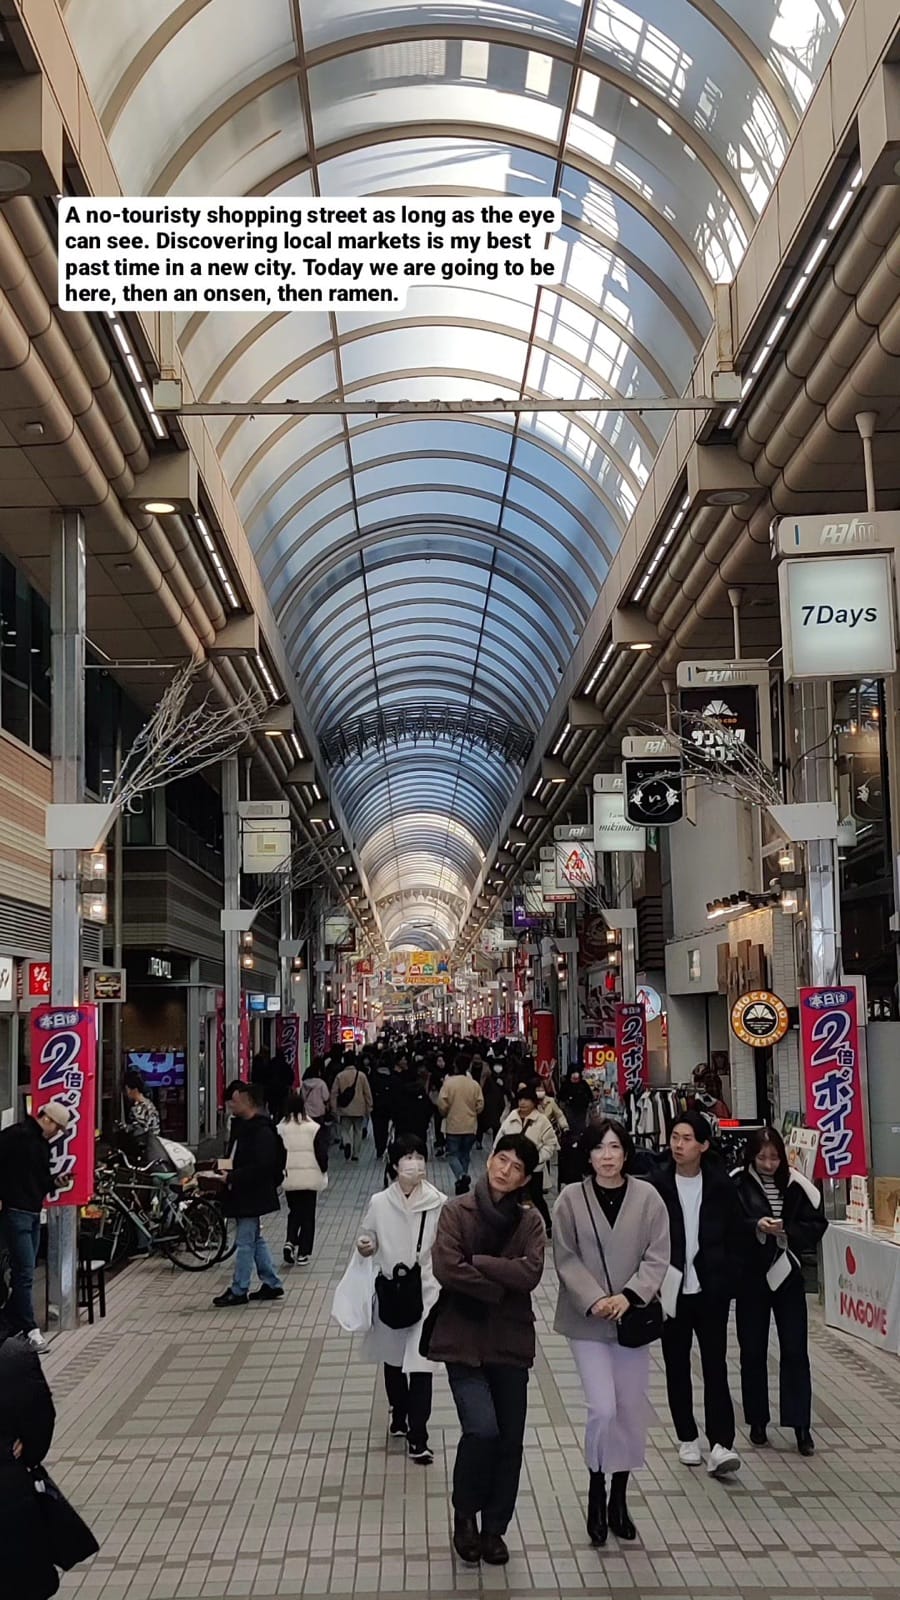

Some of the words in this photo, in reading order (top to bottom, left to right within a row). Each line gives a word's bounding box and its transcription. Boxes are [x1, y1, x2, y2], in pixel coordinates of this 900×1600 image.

[801, 605, 878, 628] 7Days
[809, 993, 847, 1008] 本日は
[40, 1013, 78, 1029] 本日は
